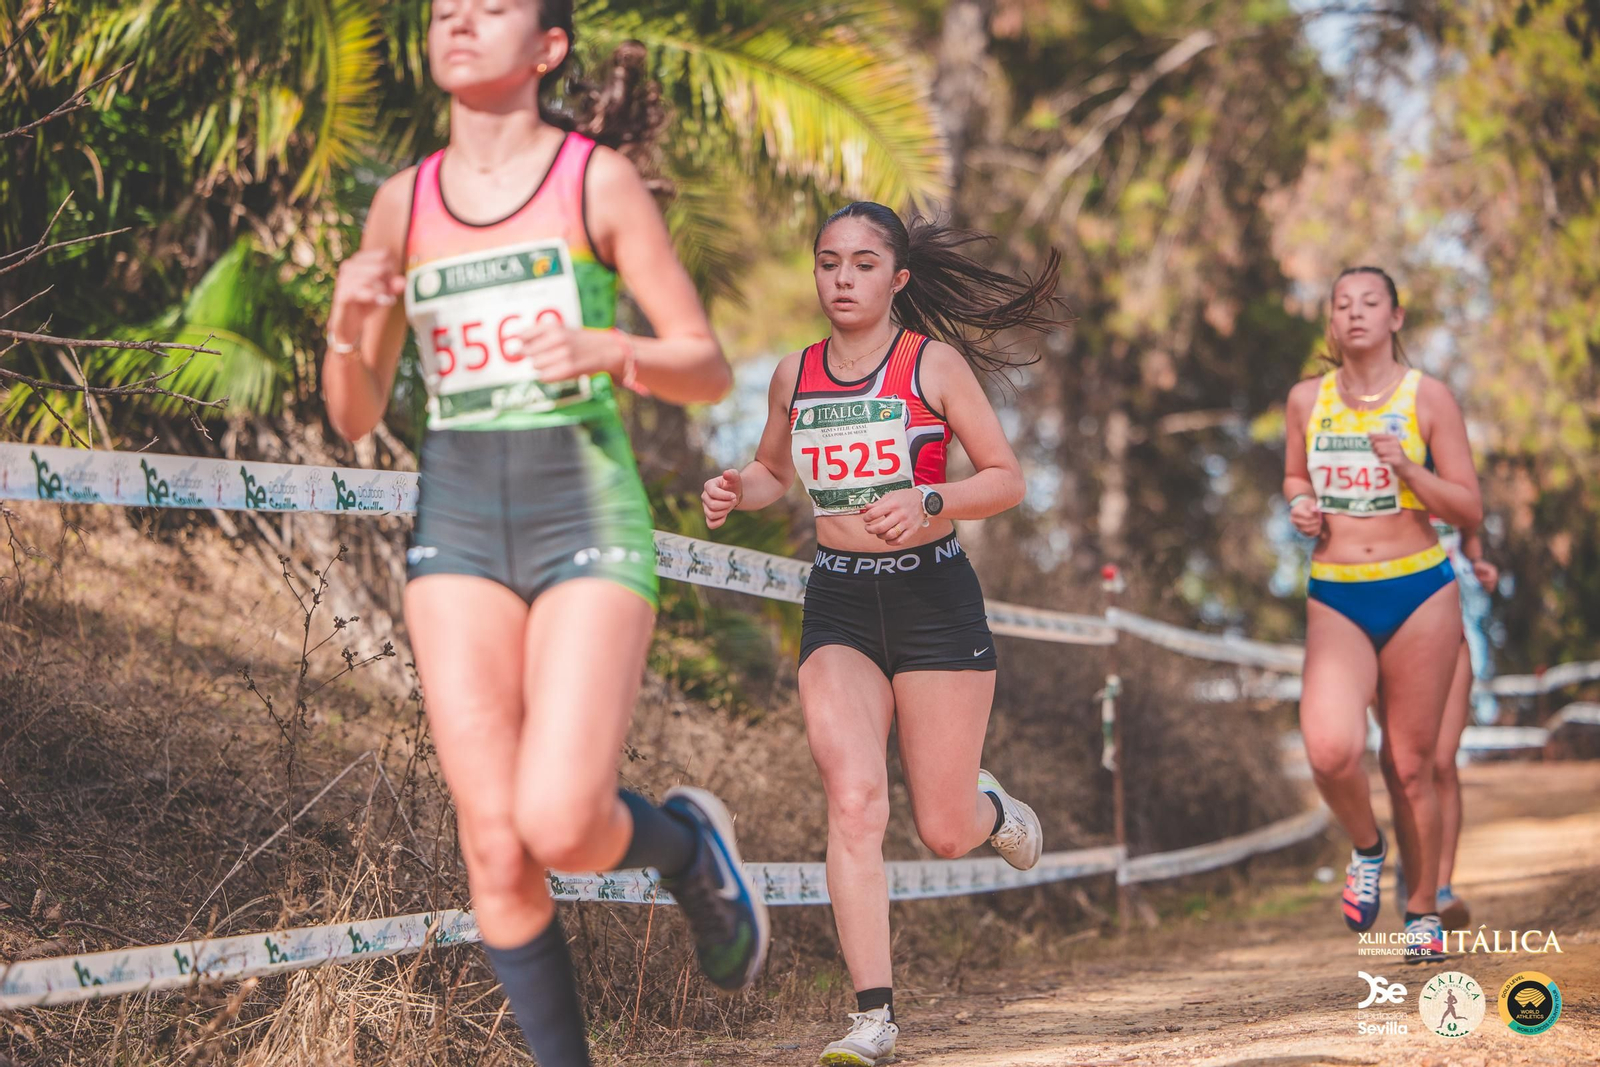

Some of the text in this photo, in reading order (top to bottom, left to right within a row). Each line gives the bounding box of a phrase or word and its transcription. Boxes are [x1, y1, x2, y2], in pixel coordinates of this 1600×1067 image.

[818, 404, 872, 420] ITÁLICA
[801, 438, 901, 481] 7525
[1318, 466, 1391, 490] 7543
[853, 553, 921, 575] PRO
